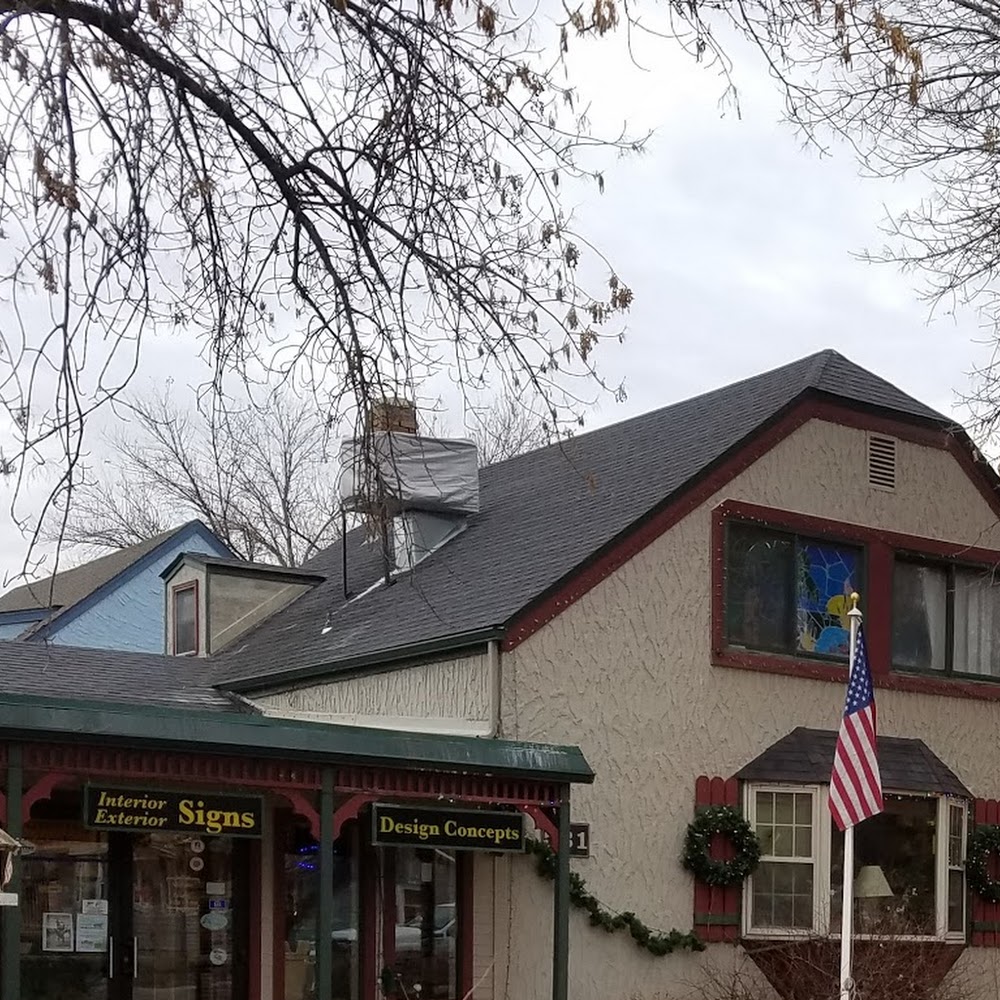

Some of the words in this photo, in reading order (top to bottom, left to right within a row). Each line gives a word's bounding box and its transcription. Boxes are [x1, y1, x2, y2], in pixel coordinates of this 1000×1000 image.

[98, 791, 167, 810] Interior
[94, 808, 167, 827] Exterior
[178, 799, 255, 834] Signs
[380, 816, 440, 840] Design
[444, 820, 520, 843] Concepts
